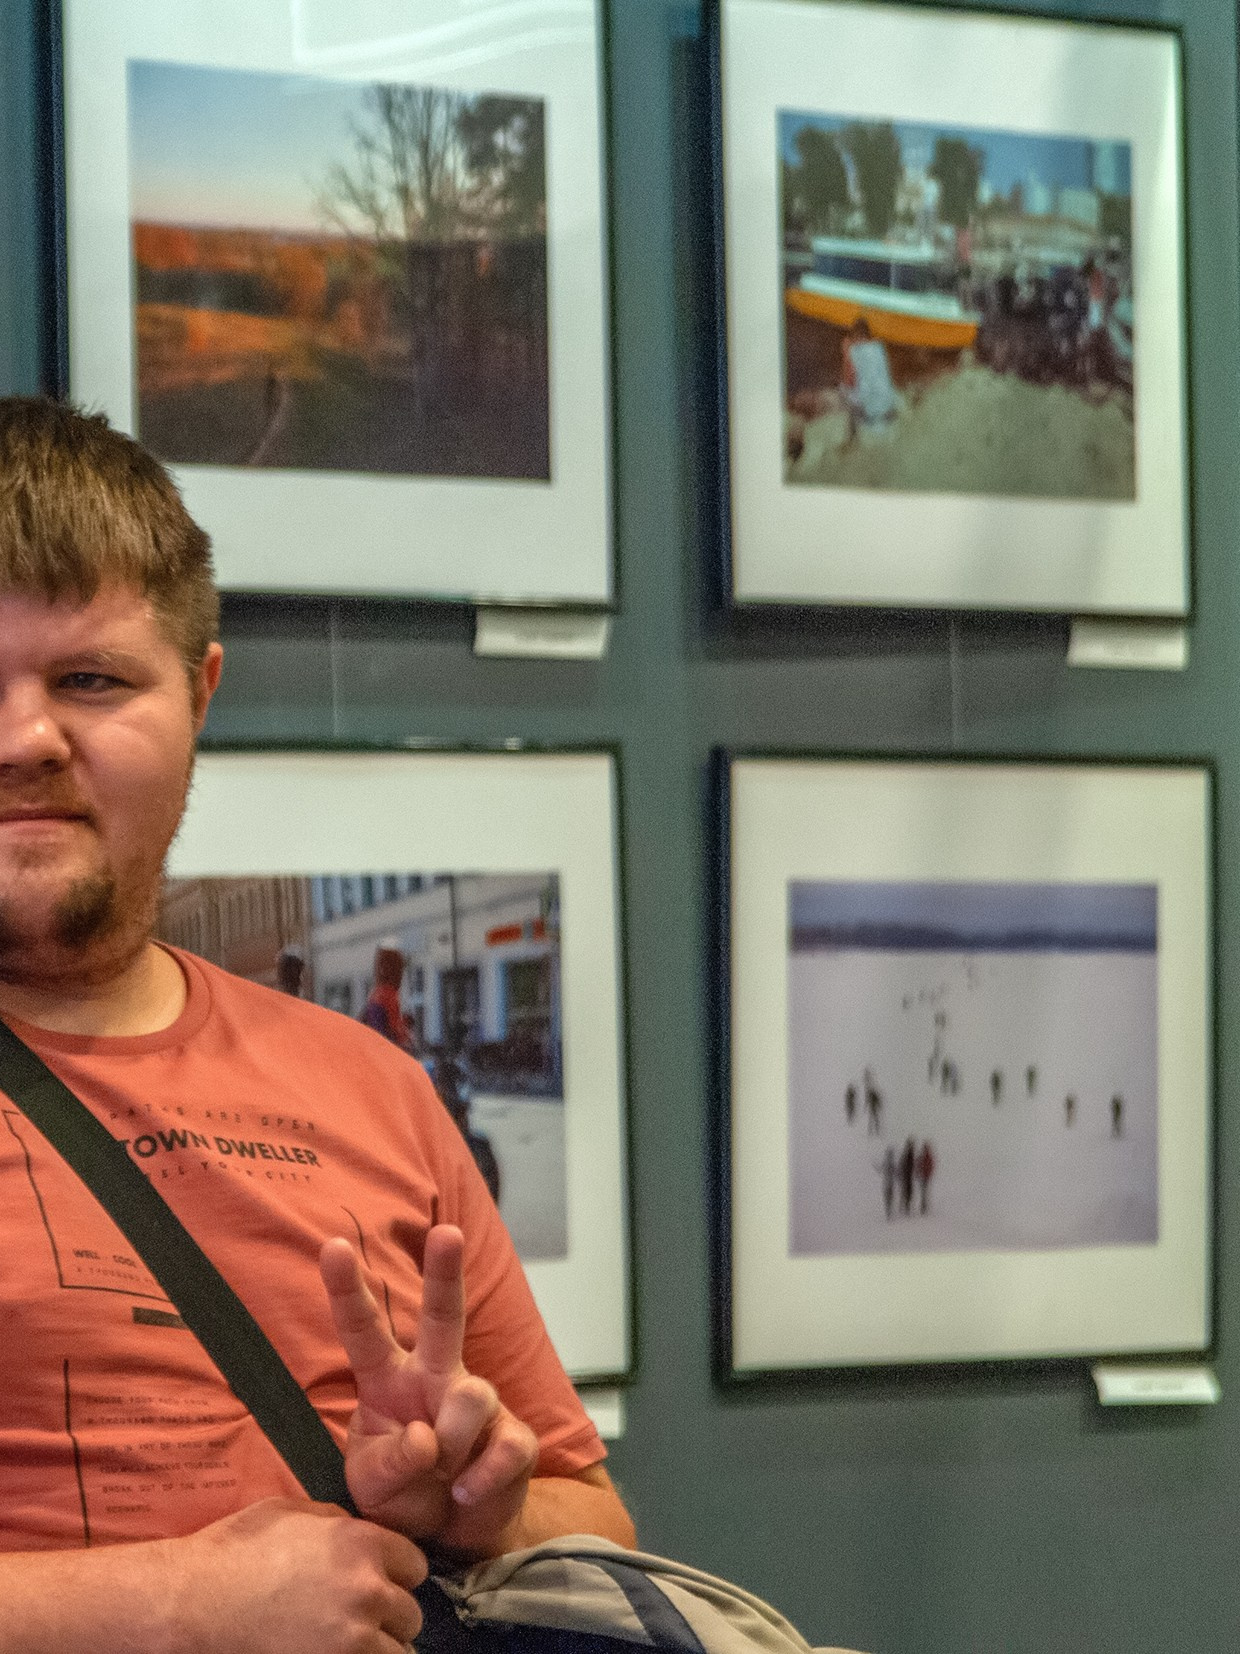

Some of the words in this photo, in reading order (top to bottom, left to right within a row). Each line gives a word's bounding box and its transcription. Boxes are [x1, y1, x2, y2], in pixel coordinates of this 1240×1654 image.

[205, 1110, 241, 1124] ARE
[261, 1116, 315, 1131] OPEN
[213, 1136, 322, 1168] DWELLER
